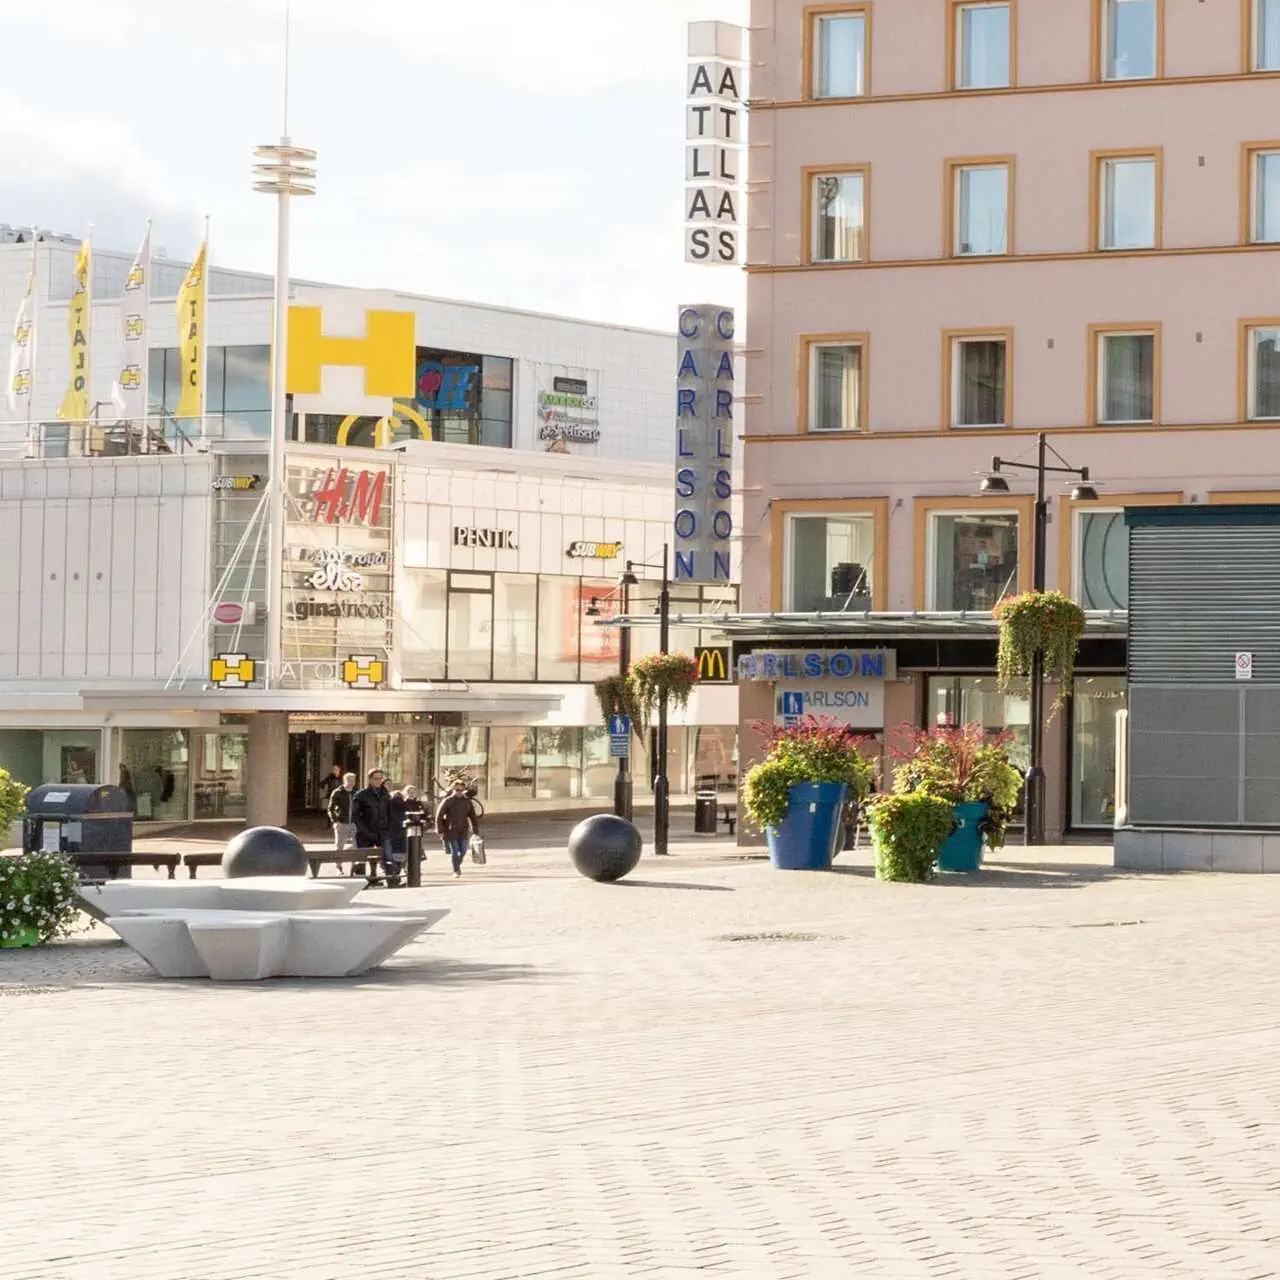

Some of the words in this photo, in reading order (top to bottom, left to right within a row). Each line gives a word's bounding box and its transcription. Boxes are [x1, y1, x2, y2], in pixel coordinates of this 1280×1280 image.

[688, 65, 711, 260] ATLAS
[716, 66, 738, 261] ATLAS
[313, 467, 386, 527] H&M
[675, 308, 699, 579] CARLSON
[714, 310, 735, 580] CARLSON
[567, 541, 622, 559] SUBWAY
[699, 649, 725, 679] M
[803, 691, 869, 708] ARLSON
